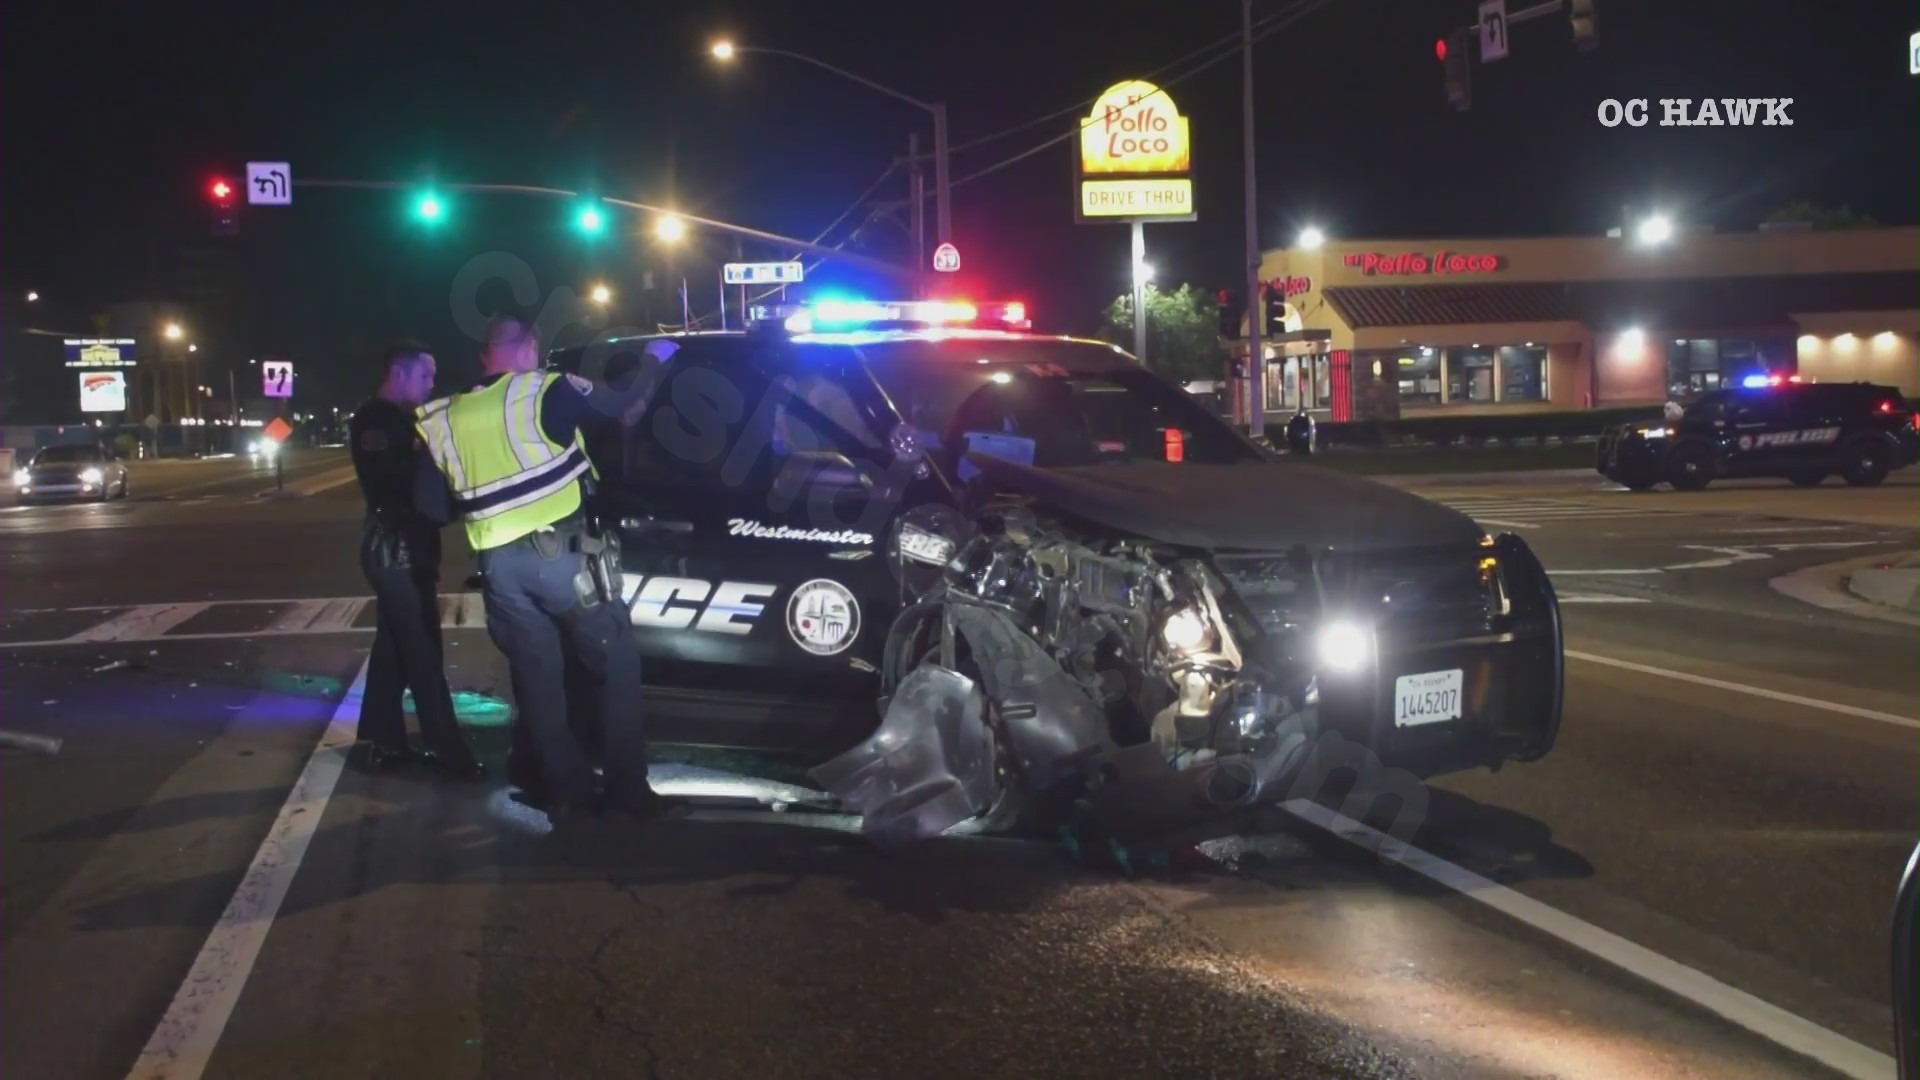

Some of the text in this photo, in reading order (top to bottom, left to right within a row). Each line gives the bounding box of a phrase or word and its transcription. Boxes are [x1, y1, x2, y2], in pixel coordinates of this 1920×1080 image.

[1105, 104, 1167, 134] Pollo
[1108, 132, 1168, 158] Loco
[1089, 189, 1185, 205] DRIVE THRU
[1362, 252, 1428, 276] Pollo
[1434, 251, 1498, 275] Loco
[727, 518, 874, 545] Westminster
[1401, 688, 1457, 719] 1445207
